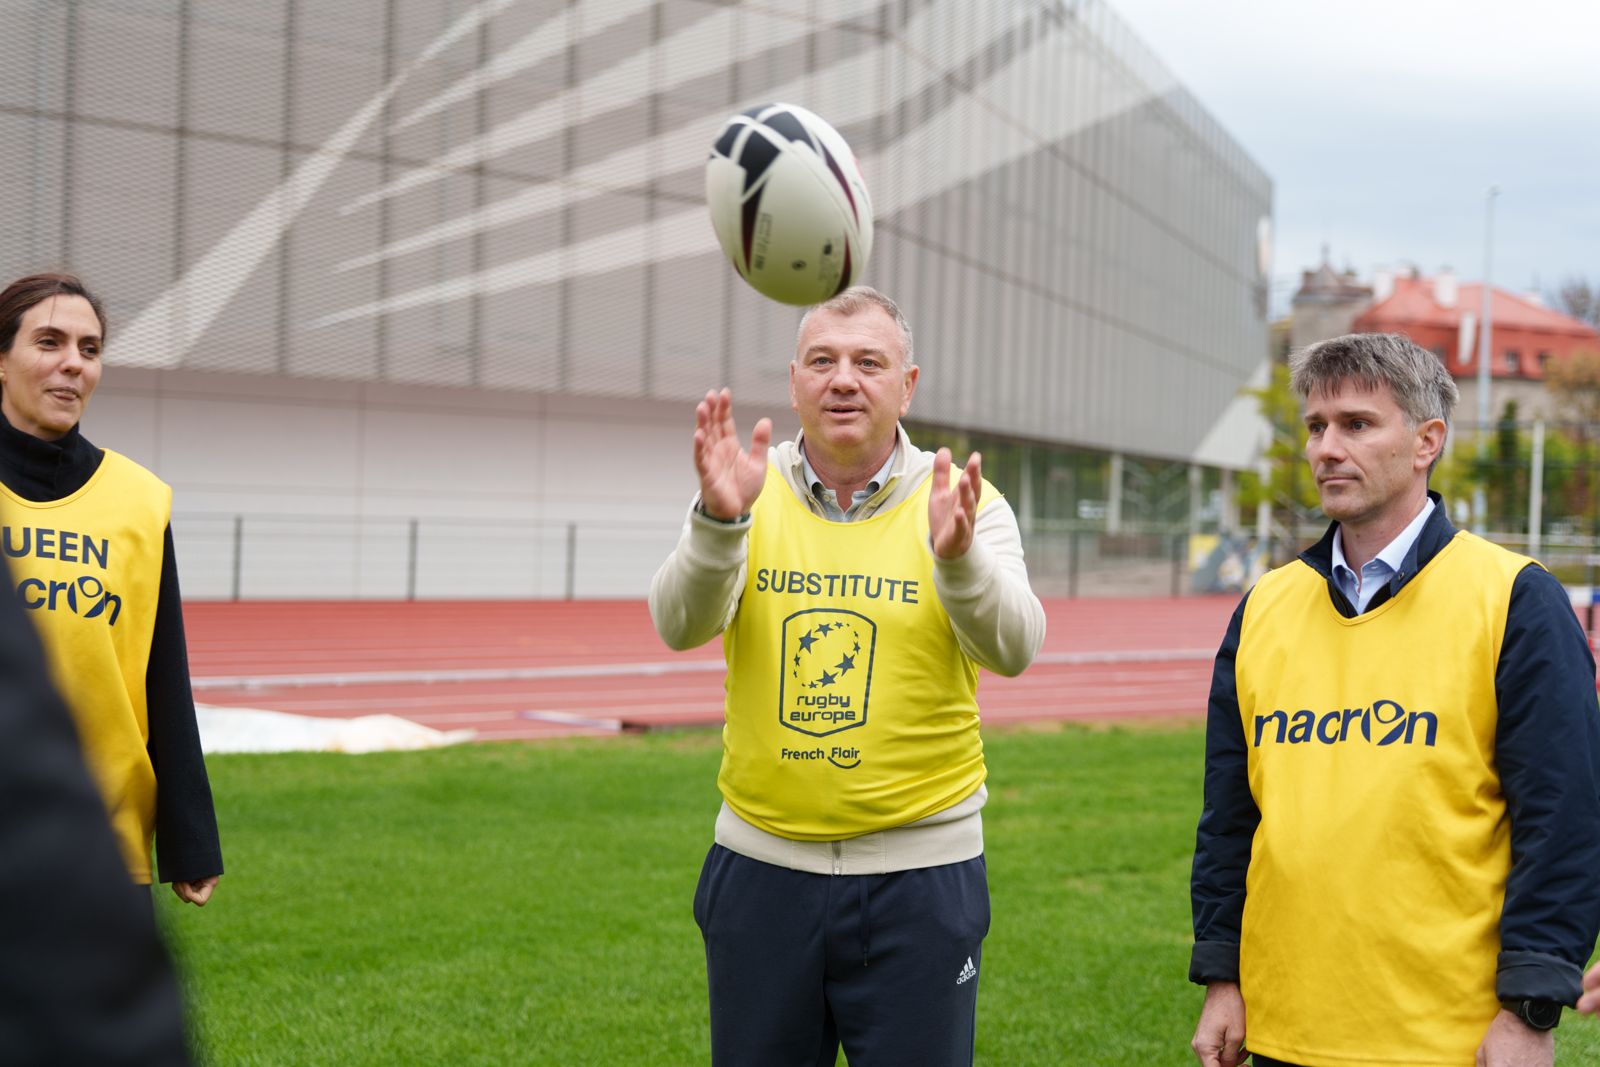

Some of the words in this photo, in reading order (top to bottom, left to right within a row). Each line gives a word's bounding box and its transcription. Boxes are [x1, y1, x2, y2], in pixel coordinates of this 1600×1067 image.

[2, 526, 109, 570] UEEN
[756, 568, 919, 604] SUBSTITUTE
[17, 575, 122, 627] cron
[796, 693, 851, 709] rugby
[789, 709, 856, 724] europe
[781, 747, 825, 760] French
[831, 747, 860, 760] Flair
[956, 967, 977, 985] adidas
